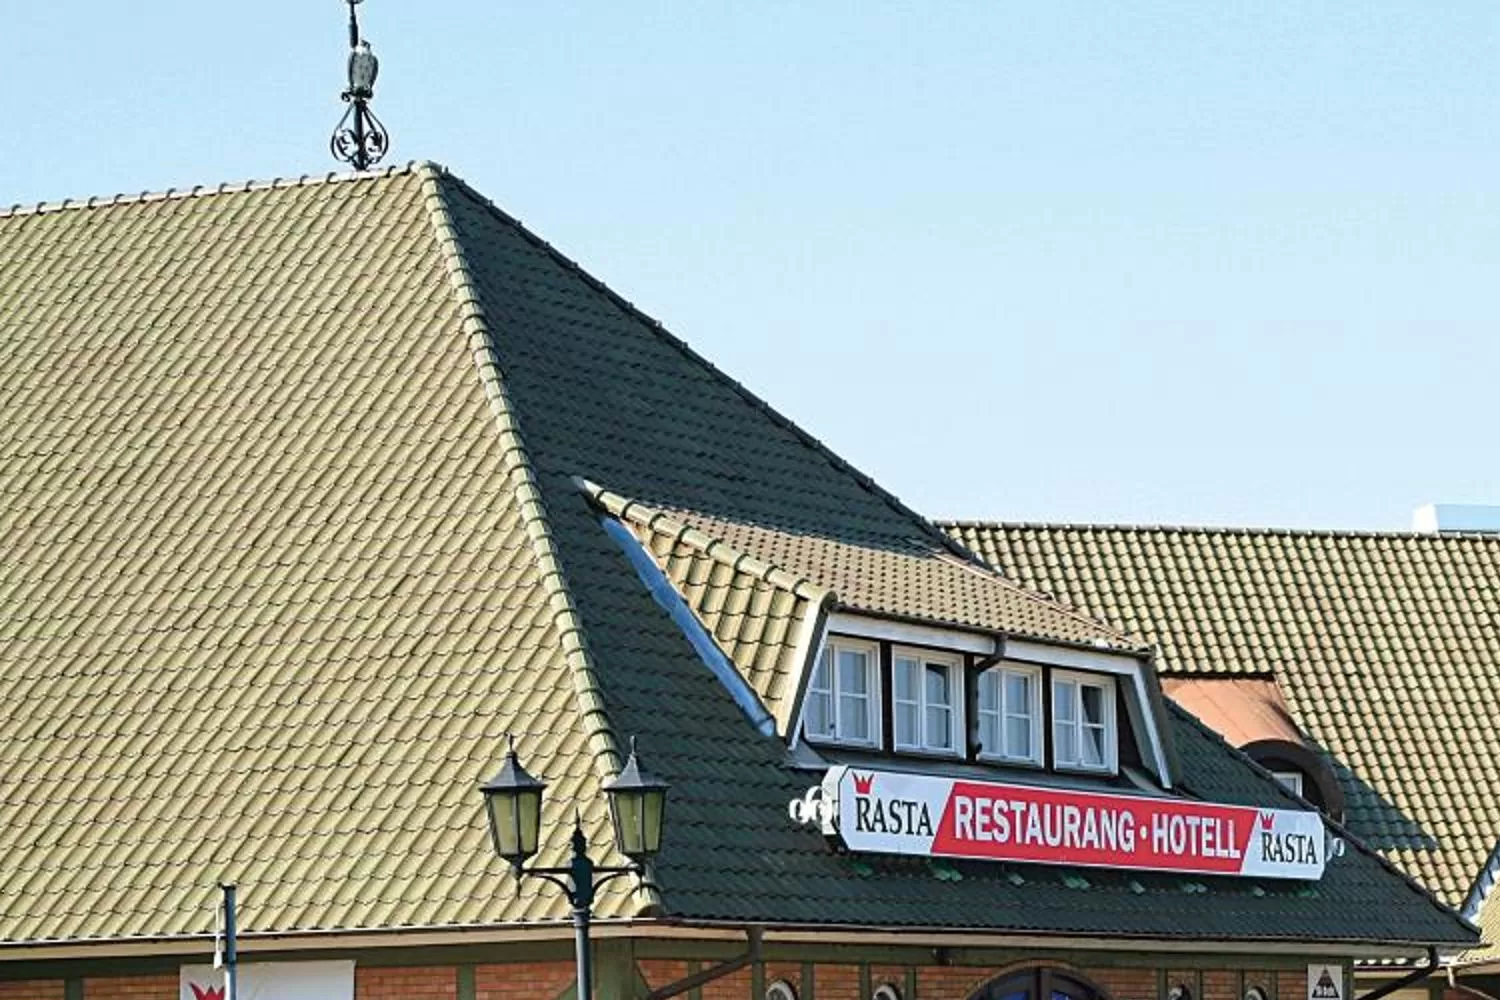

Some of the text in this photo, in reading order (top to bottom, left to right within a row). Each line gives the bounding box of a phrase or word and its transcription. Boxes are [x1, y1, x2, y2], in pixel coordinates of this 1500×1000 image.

[855, 797, 934, 837] RASTA
[954, 795, 1241, 859] RESTAURANG HOTELL
[1261, 831, 1318, 865] RASTA
